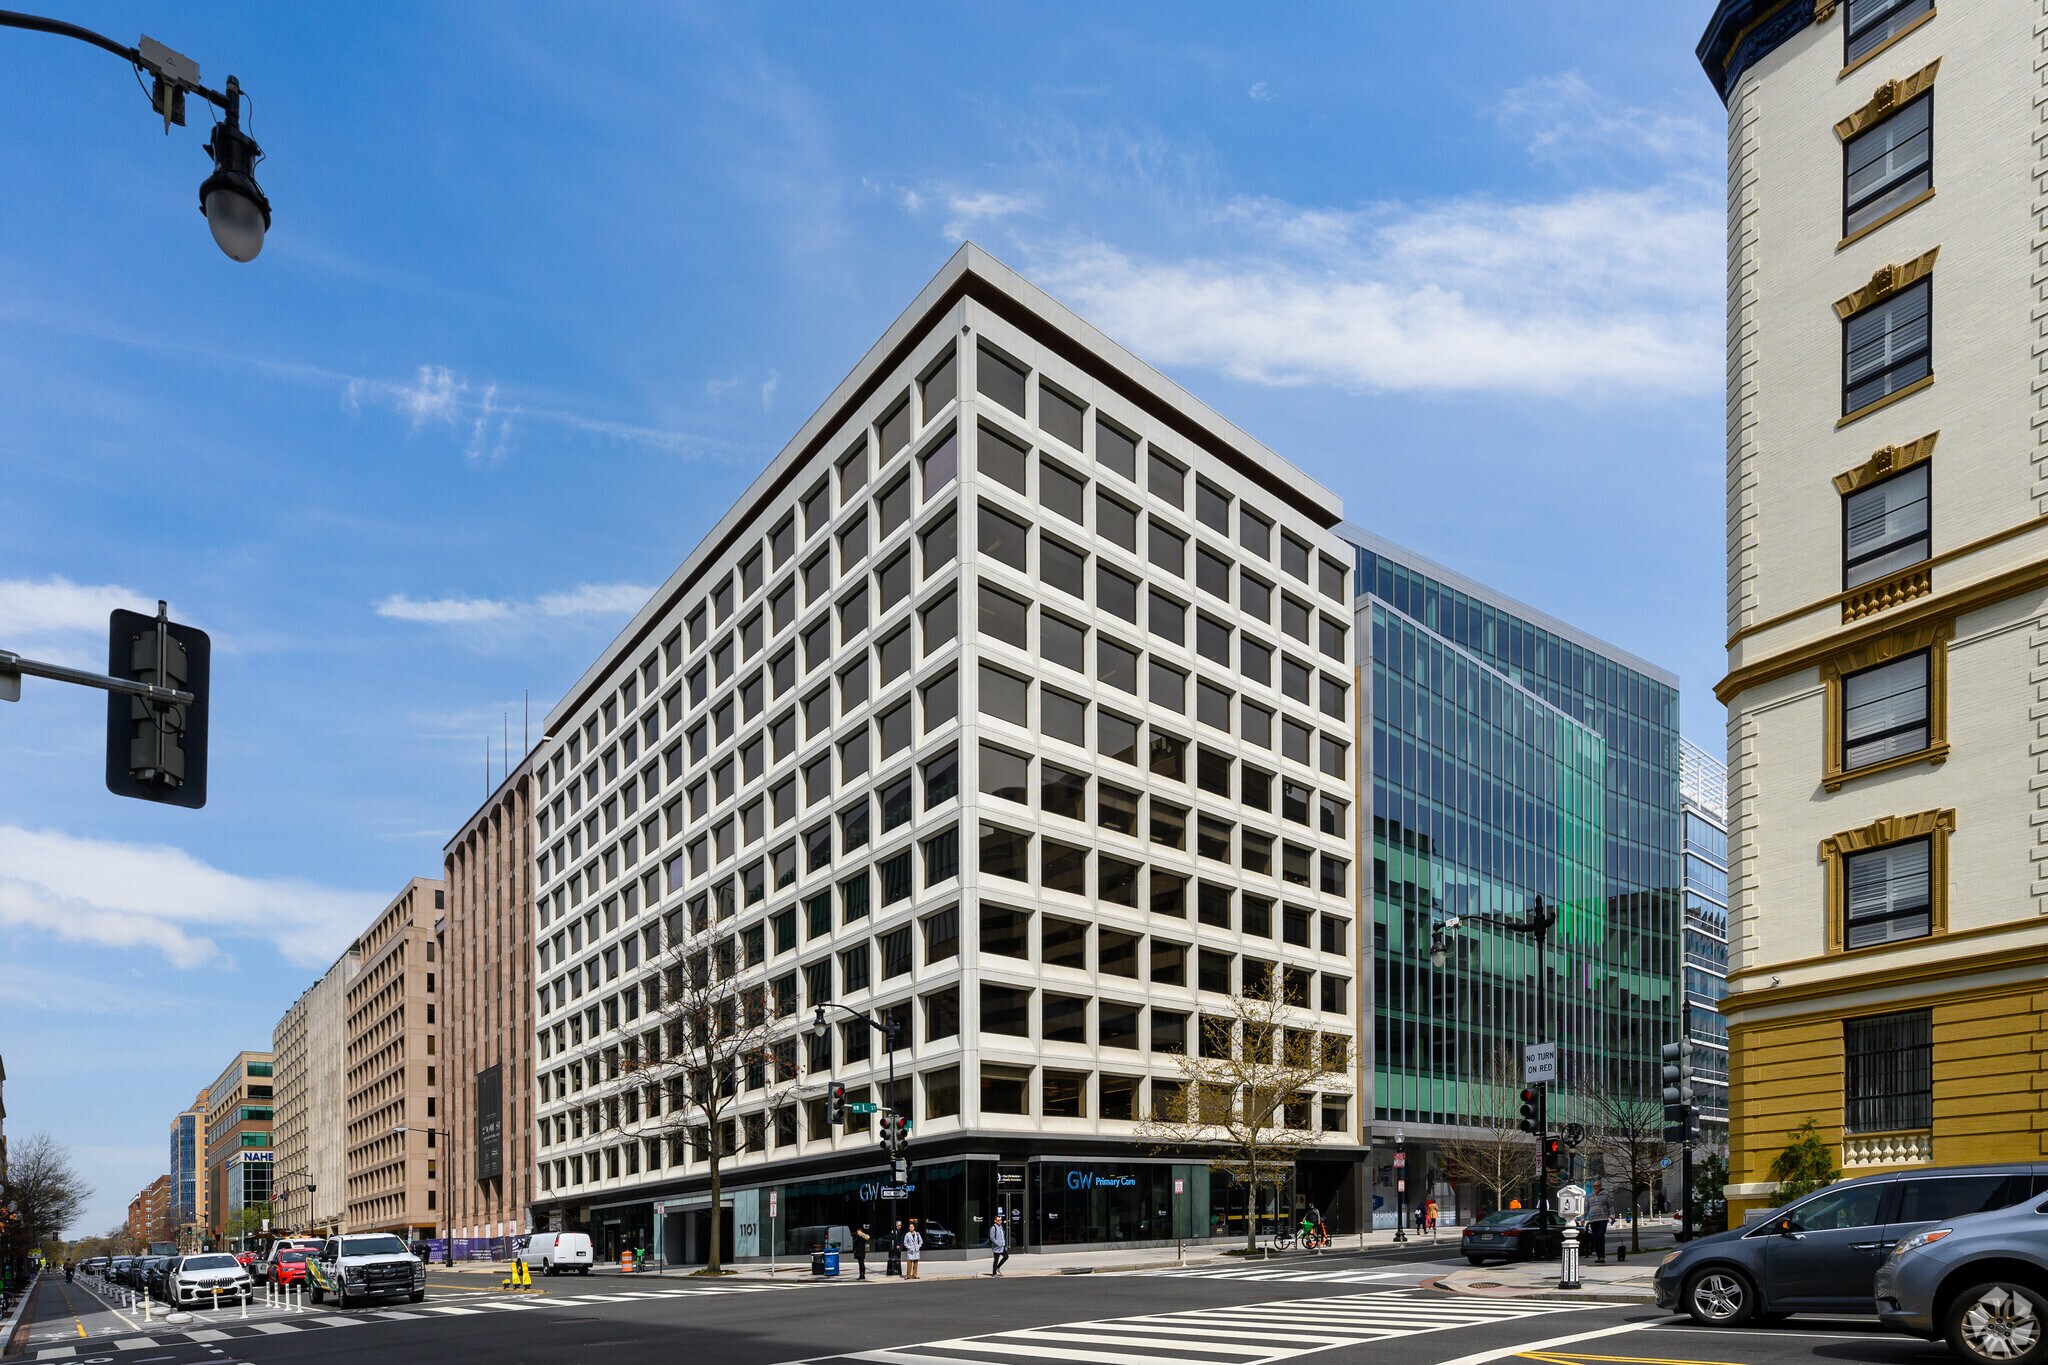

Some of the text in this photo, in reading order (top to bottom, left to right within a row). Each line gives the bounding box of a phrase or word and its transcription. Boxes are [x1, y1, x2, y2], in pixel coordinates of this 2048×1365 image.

[1527, 1052, 1554, 1062] NO TURN
[1540, 1064, 1552, 1072] RED
[862, 1104, 868, 1112] L
[1067, 1170, 1136, 1190] GW Primary Care
[860, 1182, 880, 1201] GW
[740, 1223, 756, 1236] 1101
